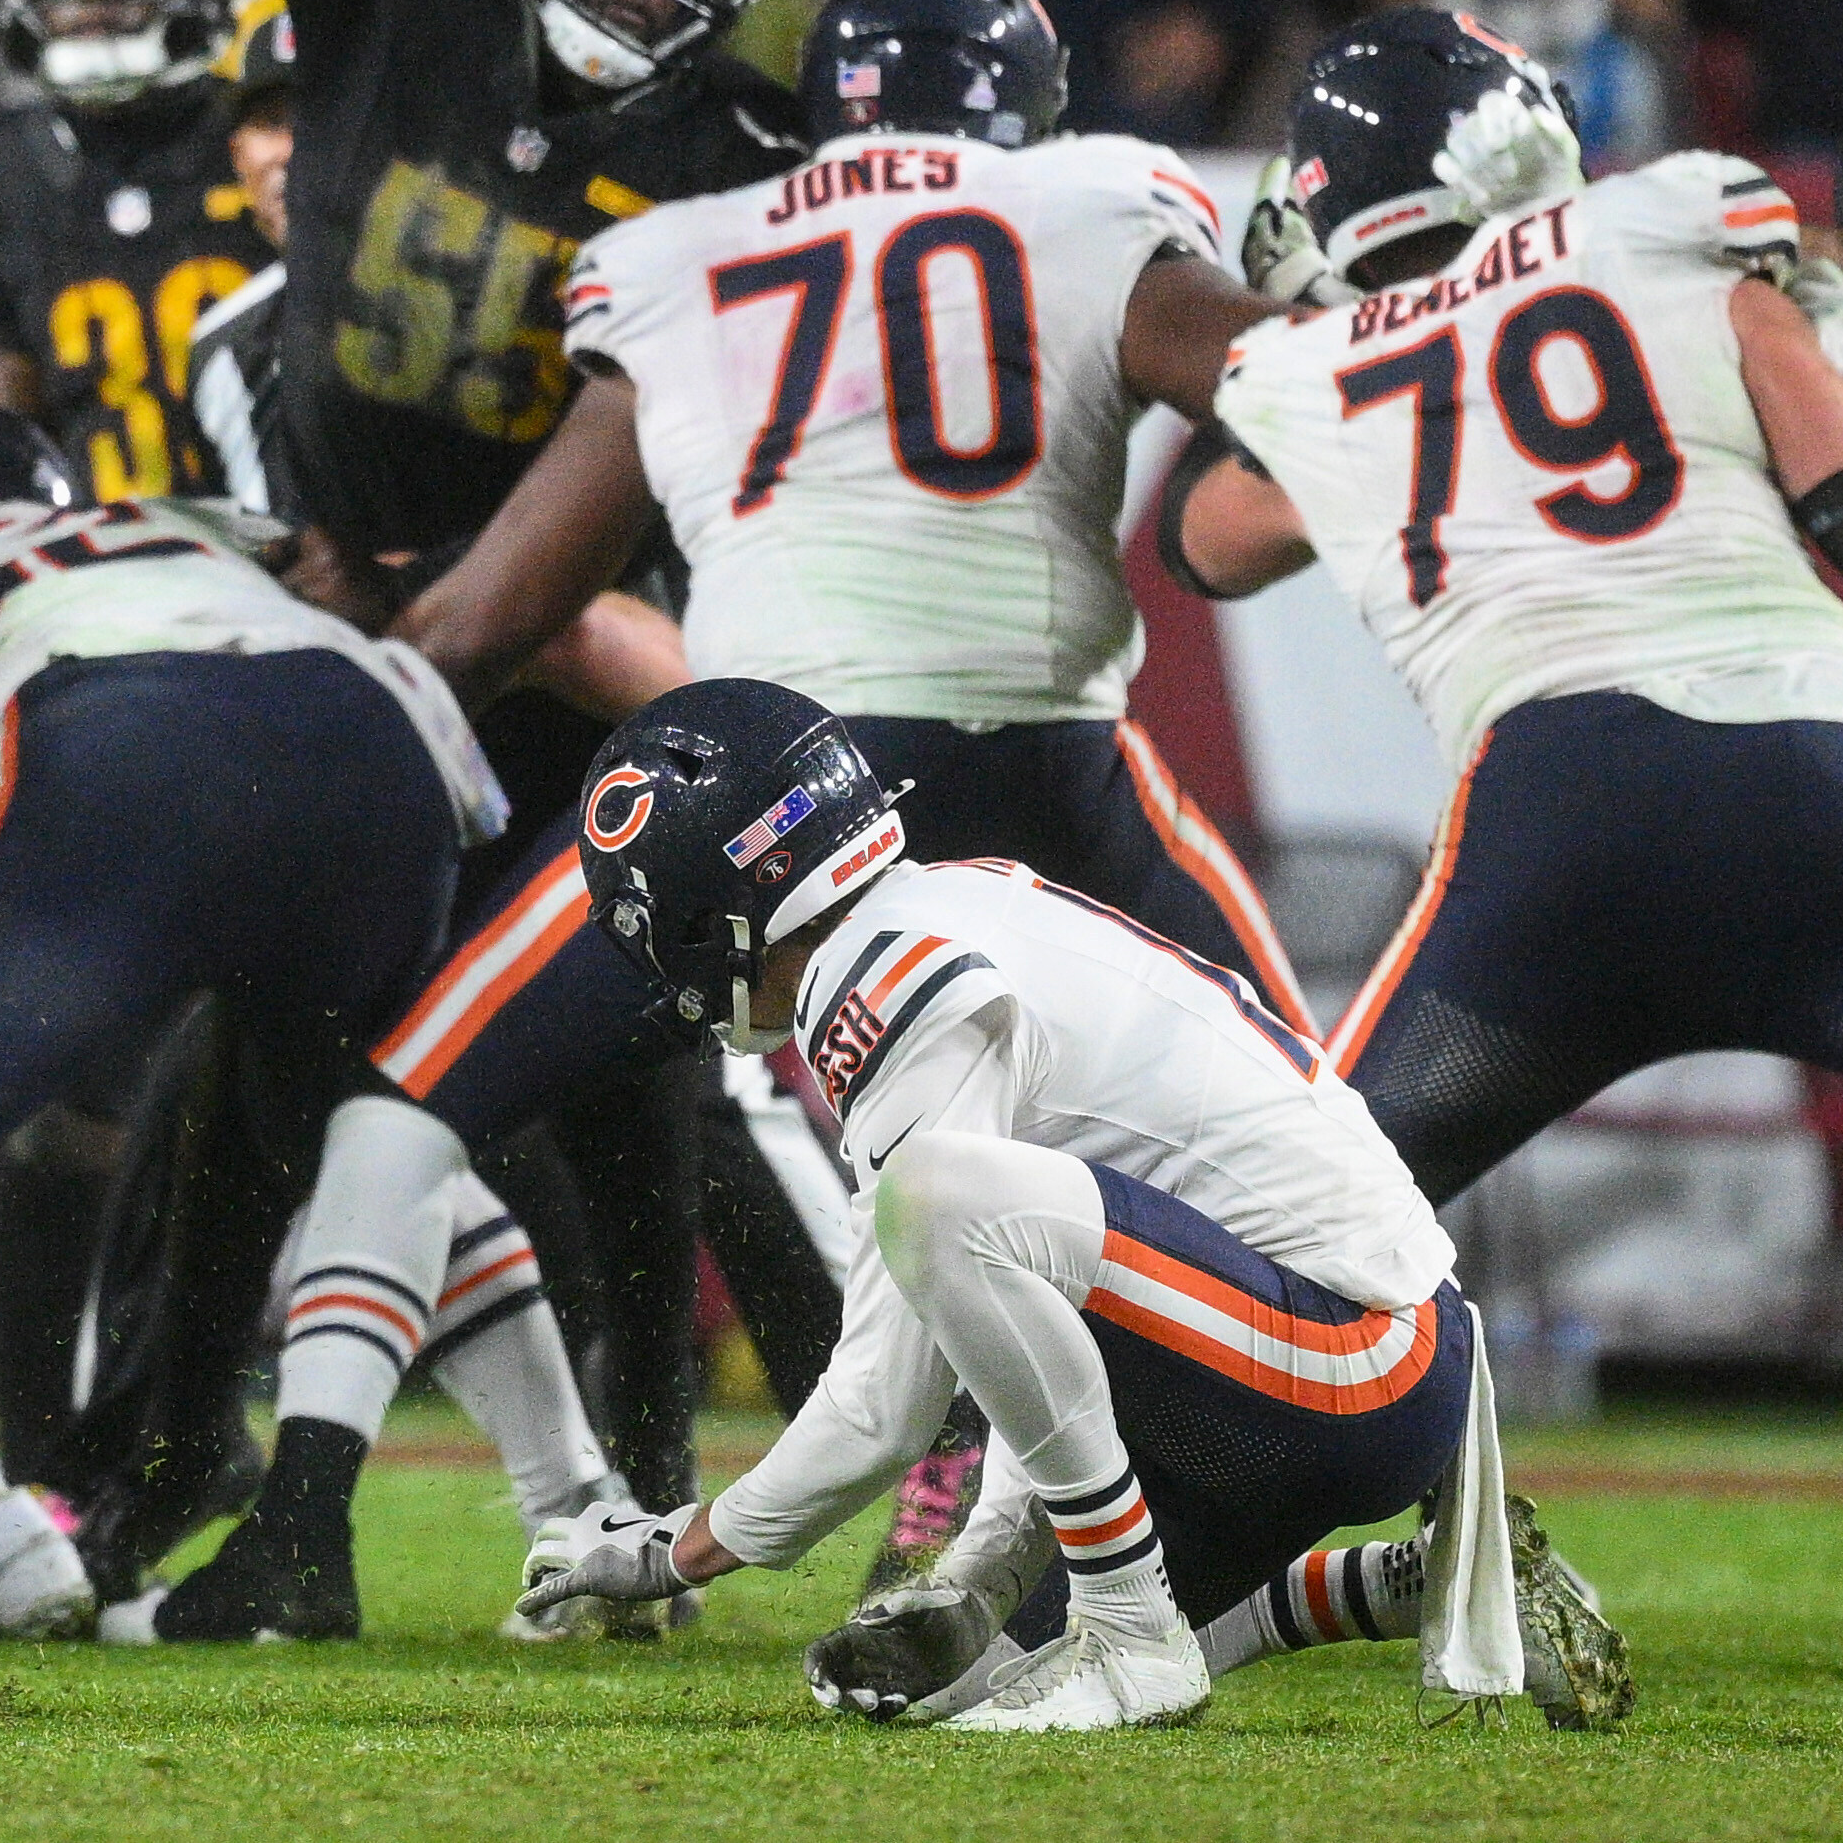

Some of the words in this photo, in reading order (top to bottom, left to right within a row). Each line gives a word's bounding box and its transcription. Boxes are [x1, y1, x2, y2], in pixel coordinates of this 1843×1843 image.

[765, 147, 964, 227] JONES
[706, 205, 1047, 520] 70
[1332, 283, 1688, 613] 79
[583, 759, 655, 855] C
[764, 859, 786, 881] 76
[830, 825, 901, 889] BEARS
